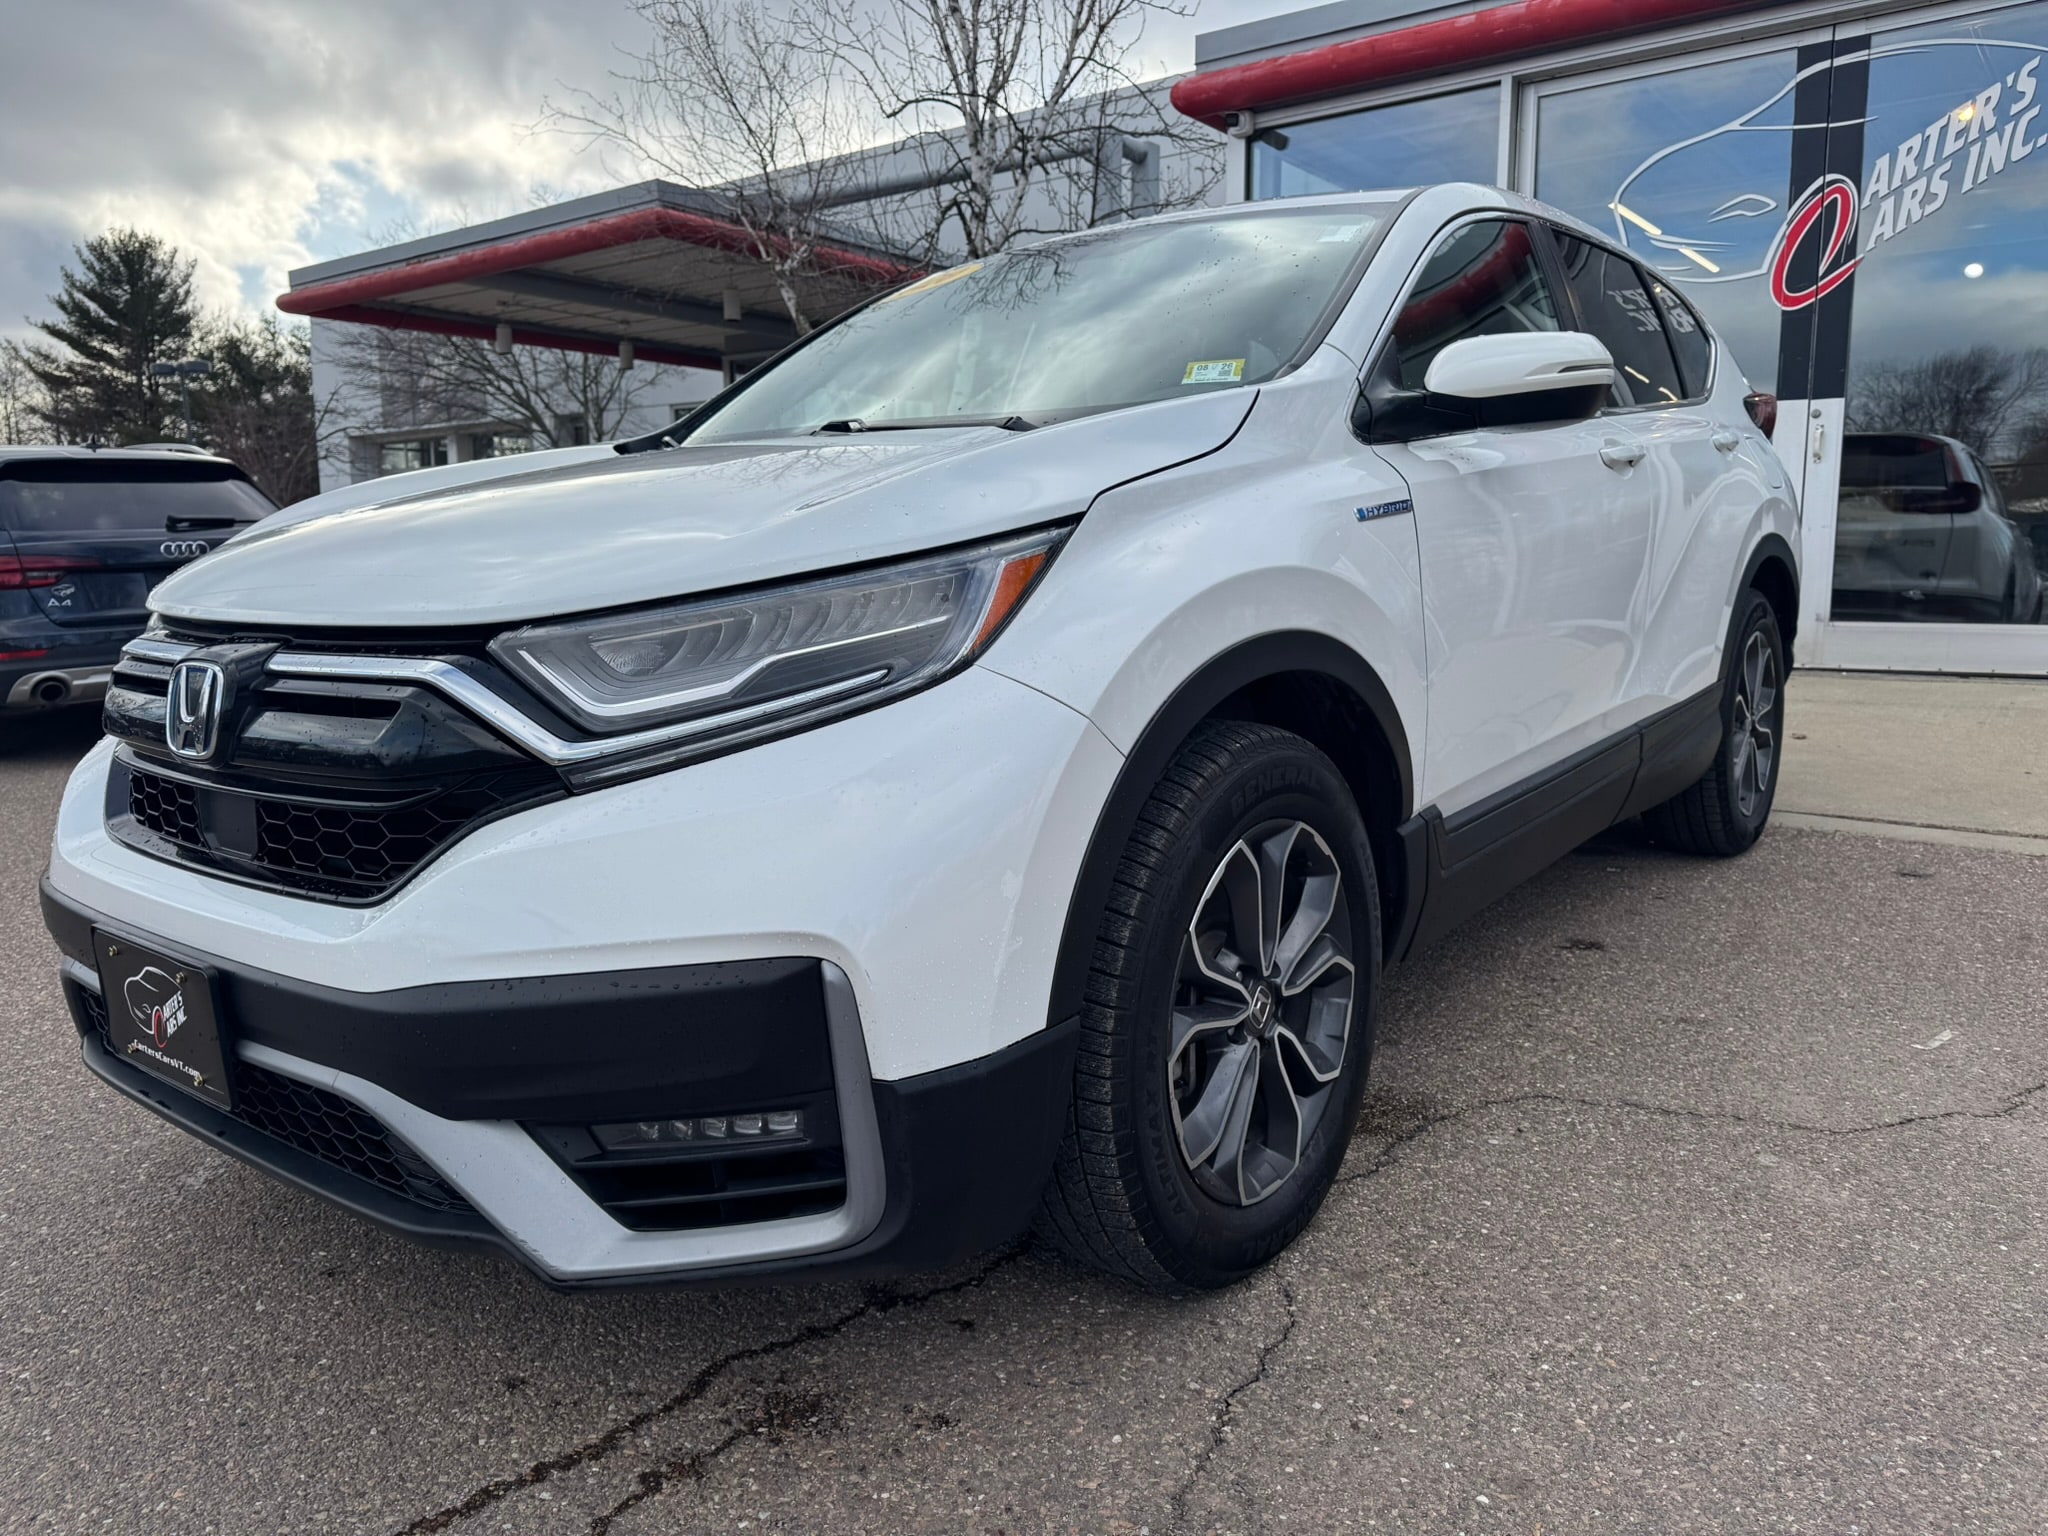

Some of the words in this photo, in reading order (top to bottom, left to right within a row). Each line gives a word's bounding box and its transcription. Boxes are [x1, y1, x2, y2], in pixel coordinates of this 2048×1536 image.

[1961, 104, 2048, 194] INC.
[1366, 501, 1409, 517] HYBRID
[48, 597, 72, 607] A4
[1231, 766, 1321, 818] GENERAL
[1144, 1088, 1187, 1215] ALTIMAX
